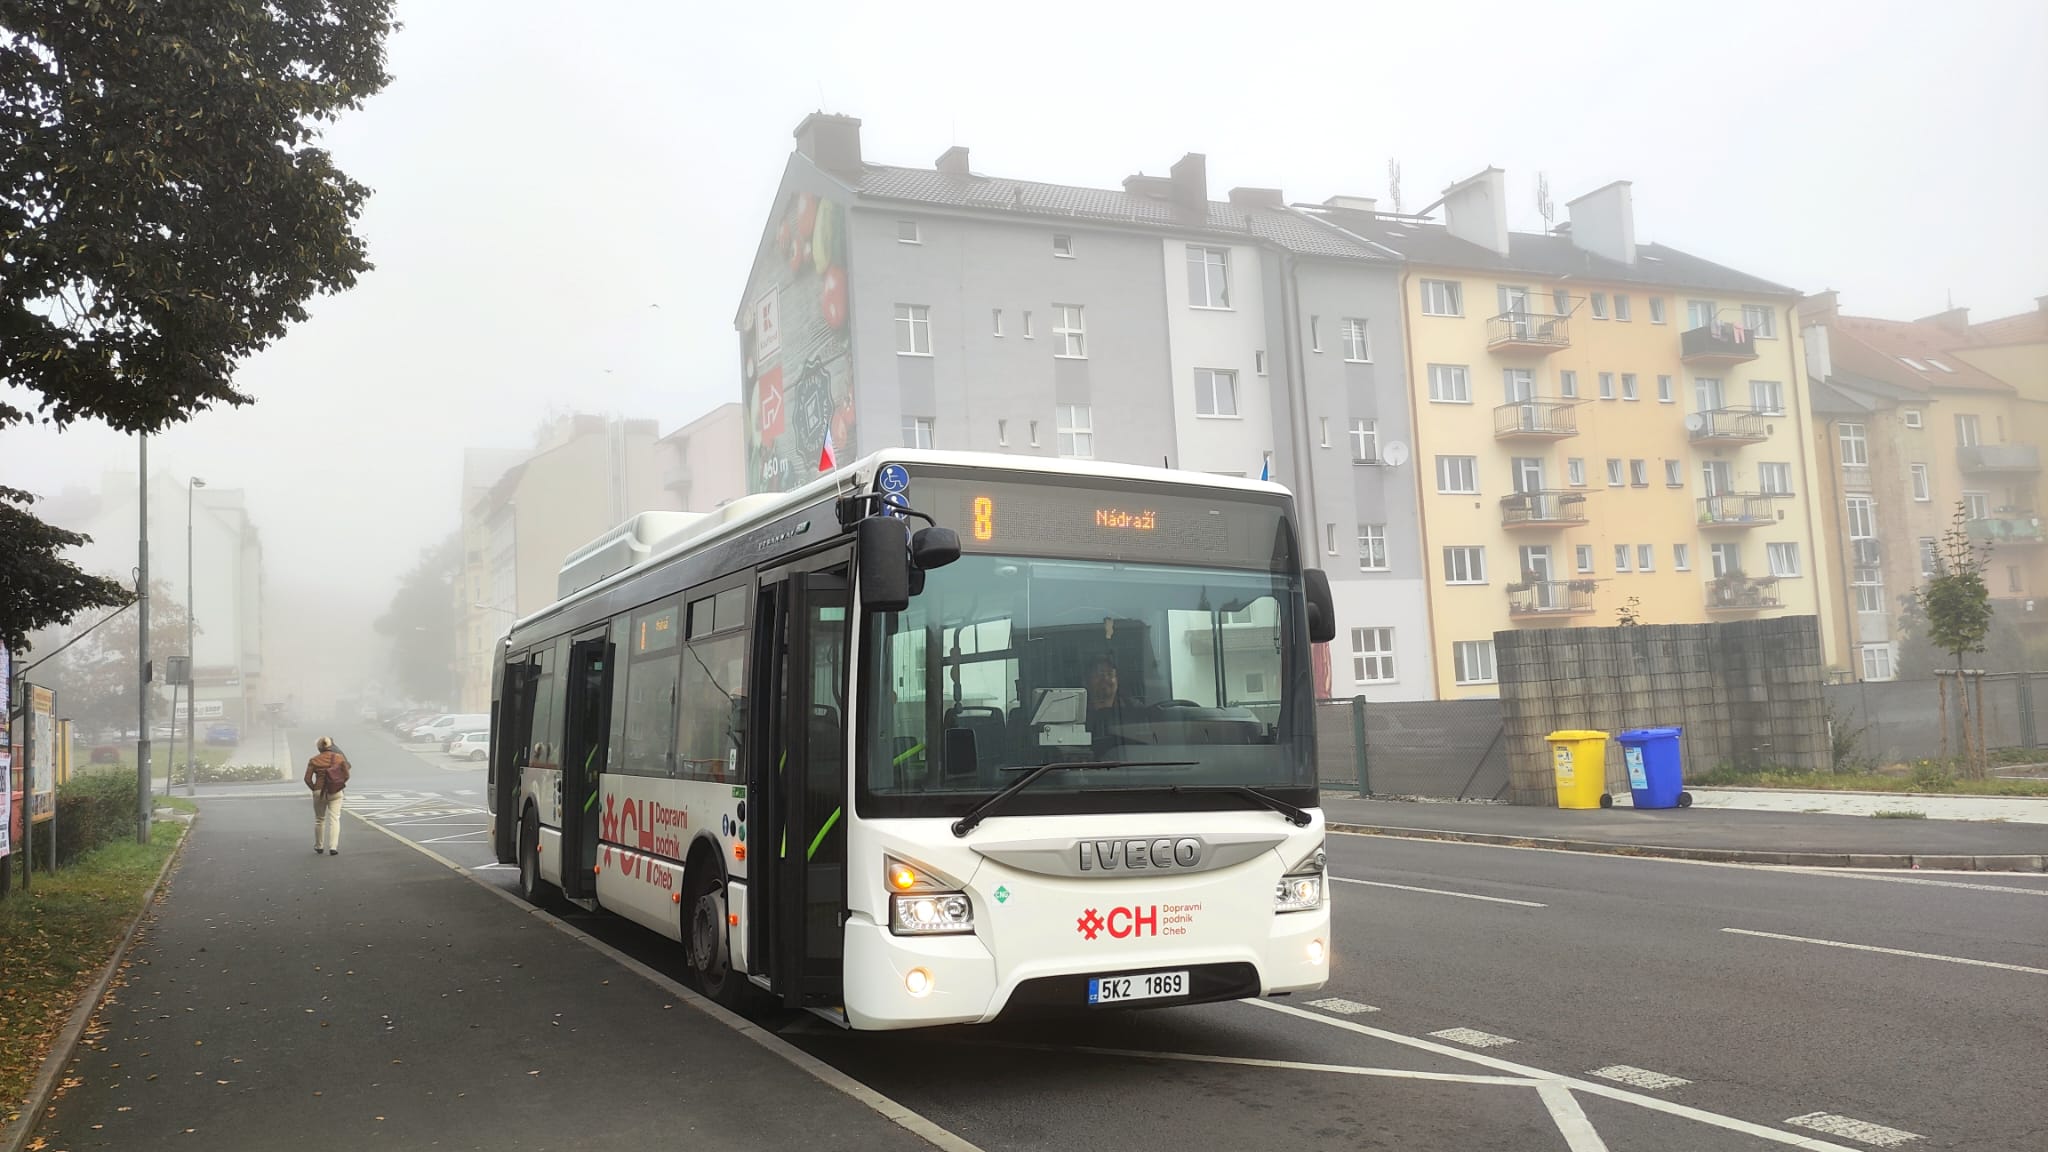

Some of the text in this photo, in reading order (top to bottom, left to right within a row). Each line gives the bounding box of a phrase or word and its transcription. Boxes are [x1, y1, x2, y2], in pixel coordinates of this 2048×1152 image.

[763, 457, 778, 481] 450
[974, 497, 1156, 540] 8 Nádraží
[655, 802, 688, 831] Dopravní
[620, 797, 654, 883] CH
[655, 833, 680, 859] podnik
[1080, 837, 1201, 871] IVECO
[653, 864, 673, 890] Cheb
[1163, 901, 1202, 914] Dopravní
[1163, 914, 1192, 925] podnik
[1107, 905, 1157, 939] CH
[1163, 926, 1186, 936] Cheb
[1102, 975, 1182, 999] 5K2 1869
